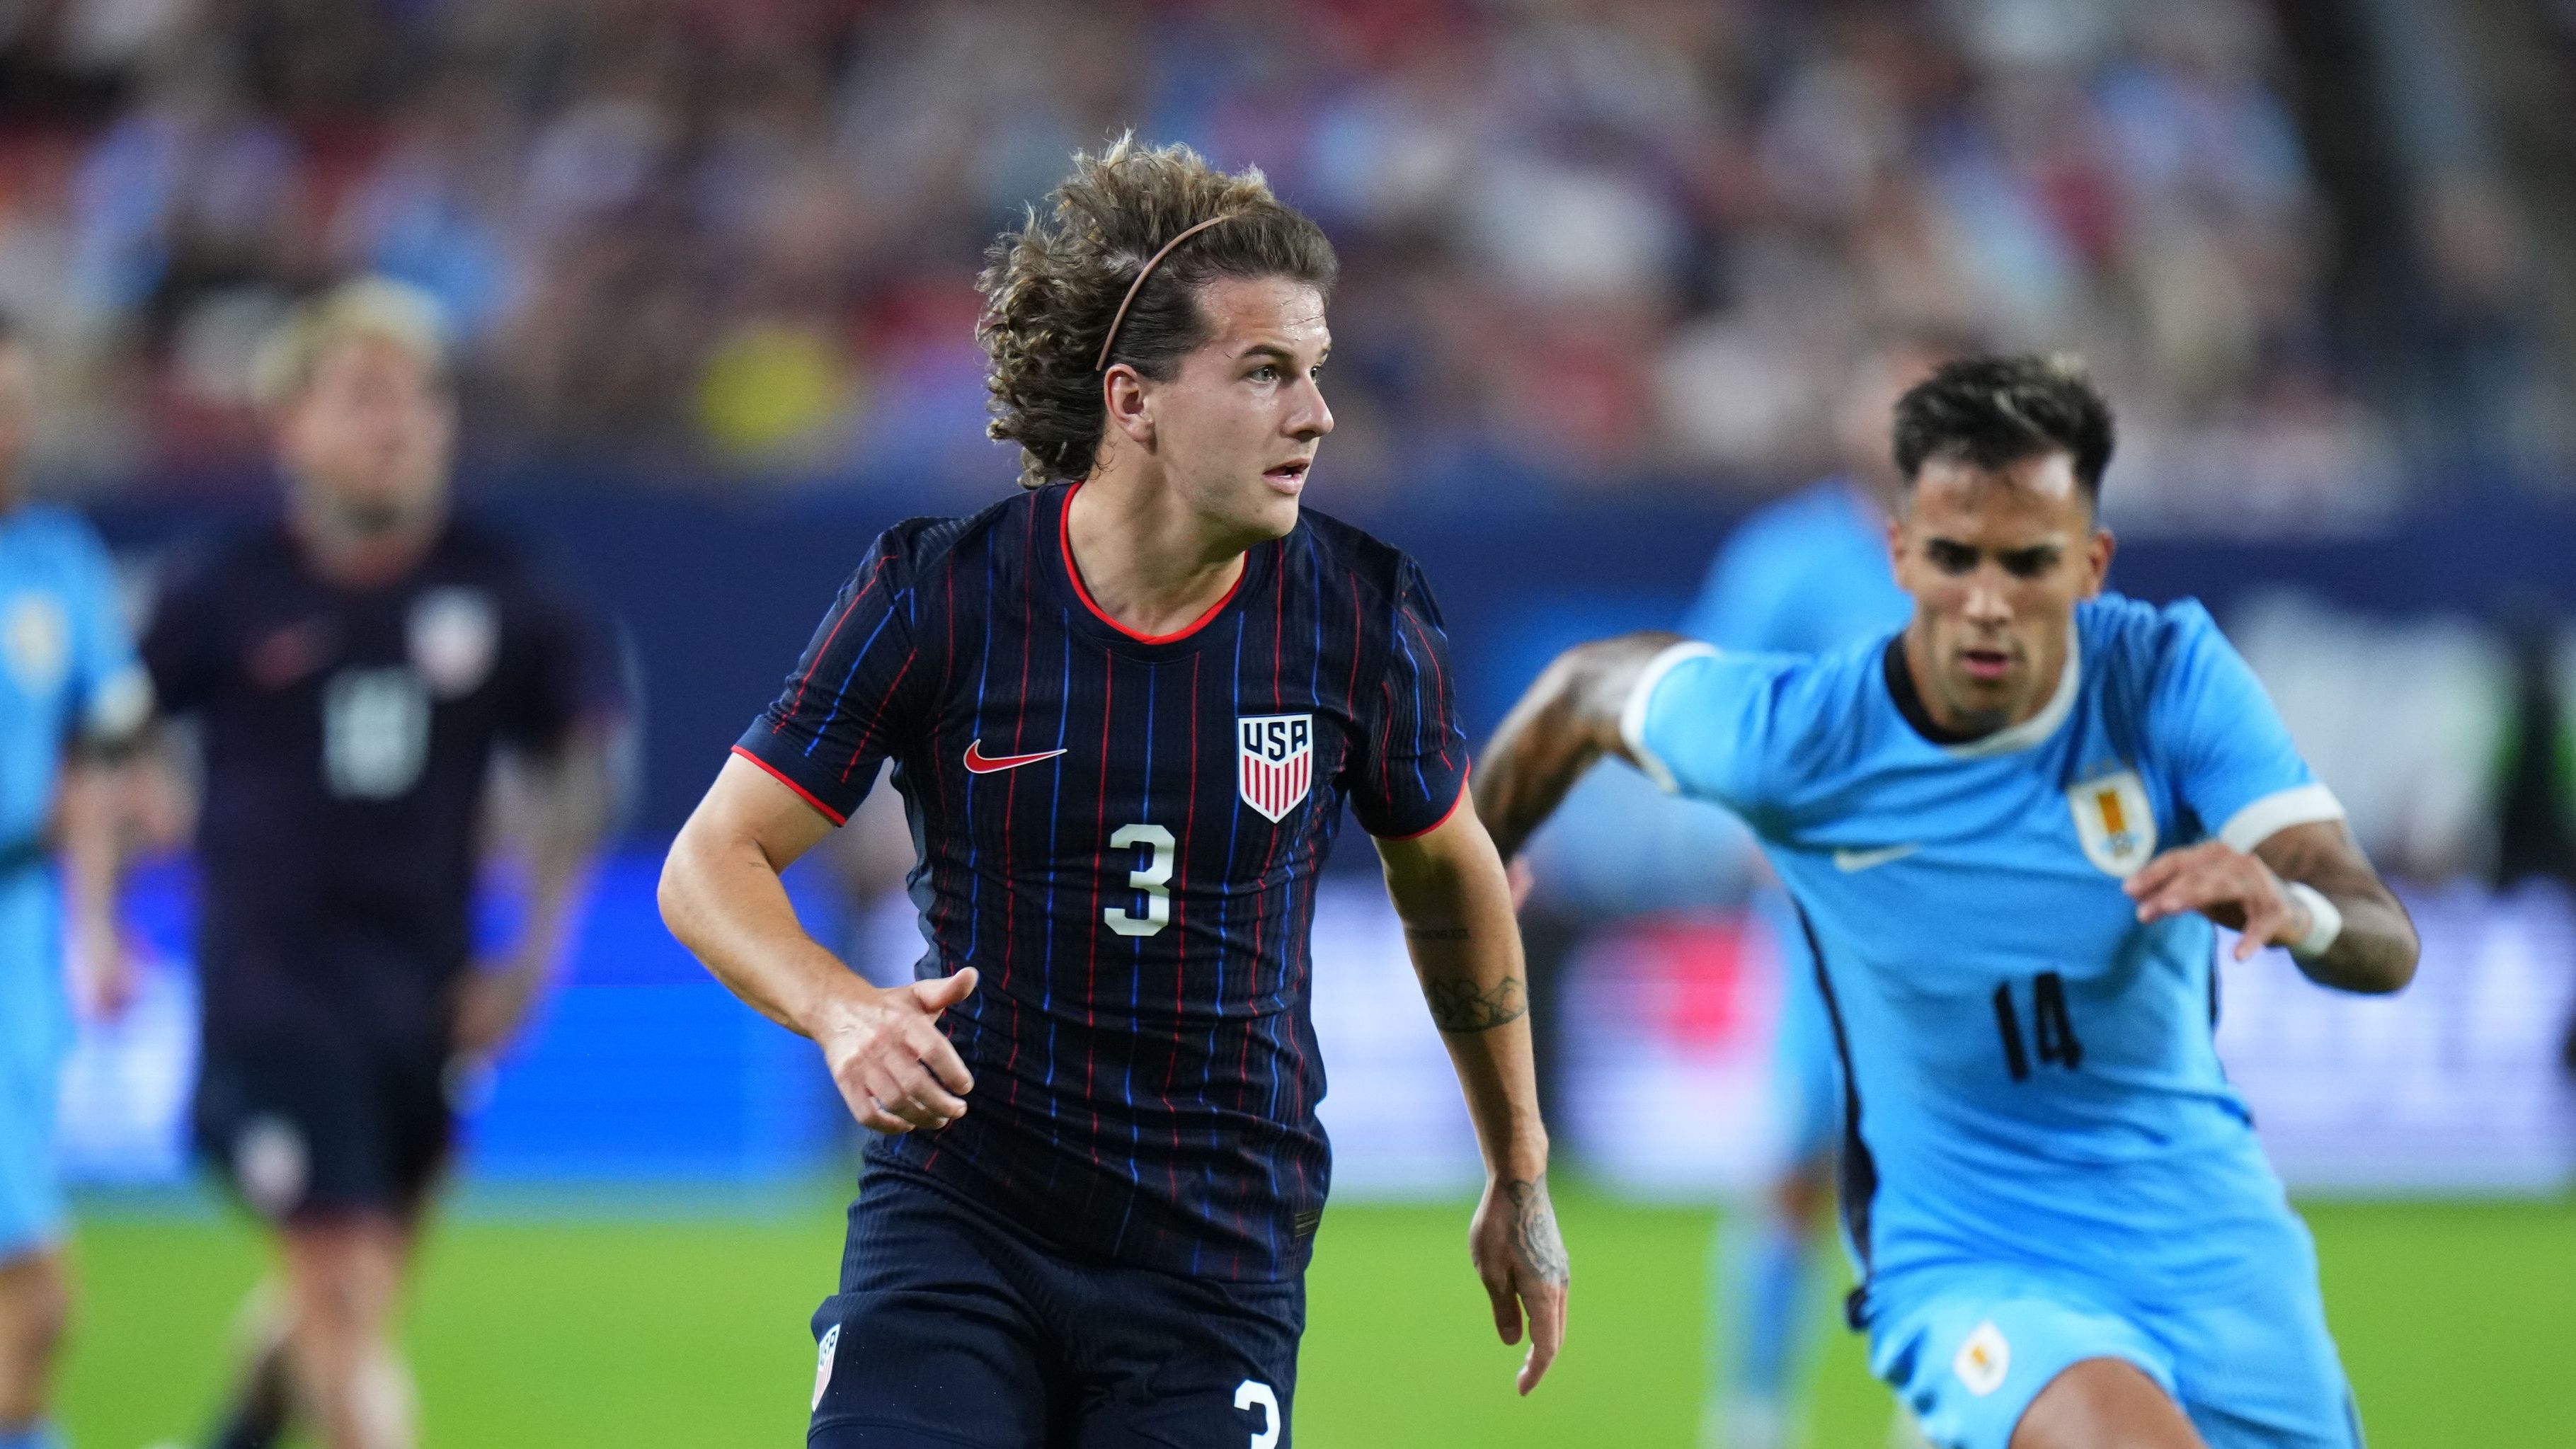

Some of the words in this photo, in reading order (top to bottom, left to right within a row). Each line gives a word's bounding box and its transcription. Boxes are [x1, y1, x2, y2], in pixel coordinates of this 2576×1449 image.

[1244, 720, 1308, 762] USA
[1104, 824, 1176, 937] 3
[1993, 972, 2082, 1080] 14
